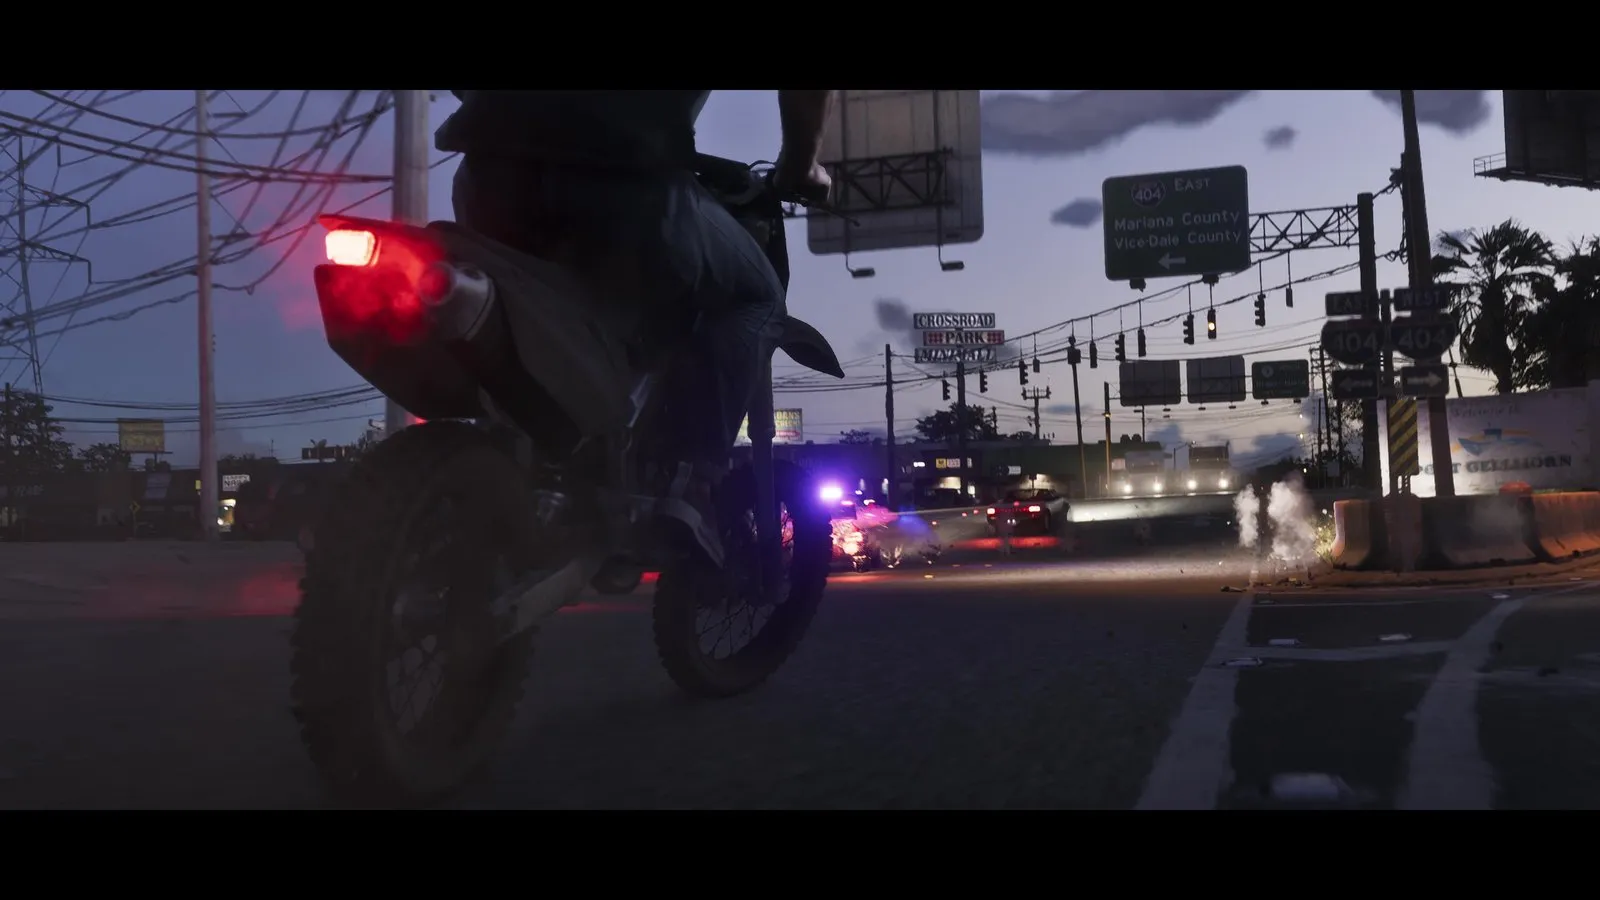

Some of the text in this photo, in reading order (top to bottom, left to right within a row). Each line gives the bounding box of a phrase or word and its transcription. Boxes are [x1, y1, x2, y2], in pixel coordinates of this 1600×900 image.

[1134, 188, 1162, 202] 404
[1114, 210, 1240, 232] Mariana County
[1114, 230, 1242, 250] Vice-Dale County
[918, 314, 993, 328] CROSSROAD
[945, 332, 985, 344] PARK
[1398, 328, 1447, 350] 404
